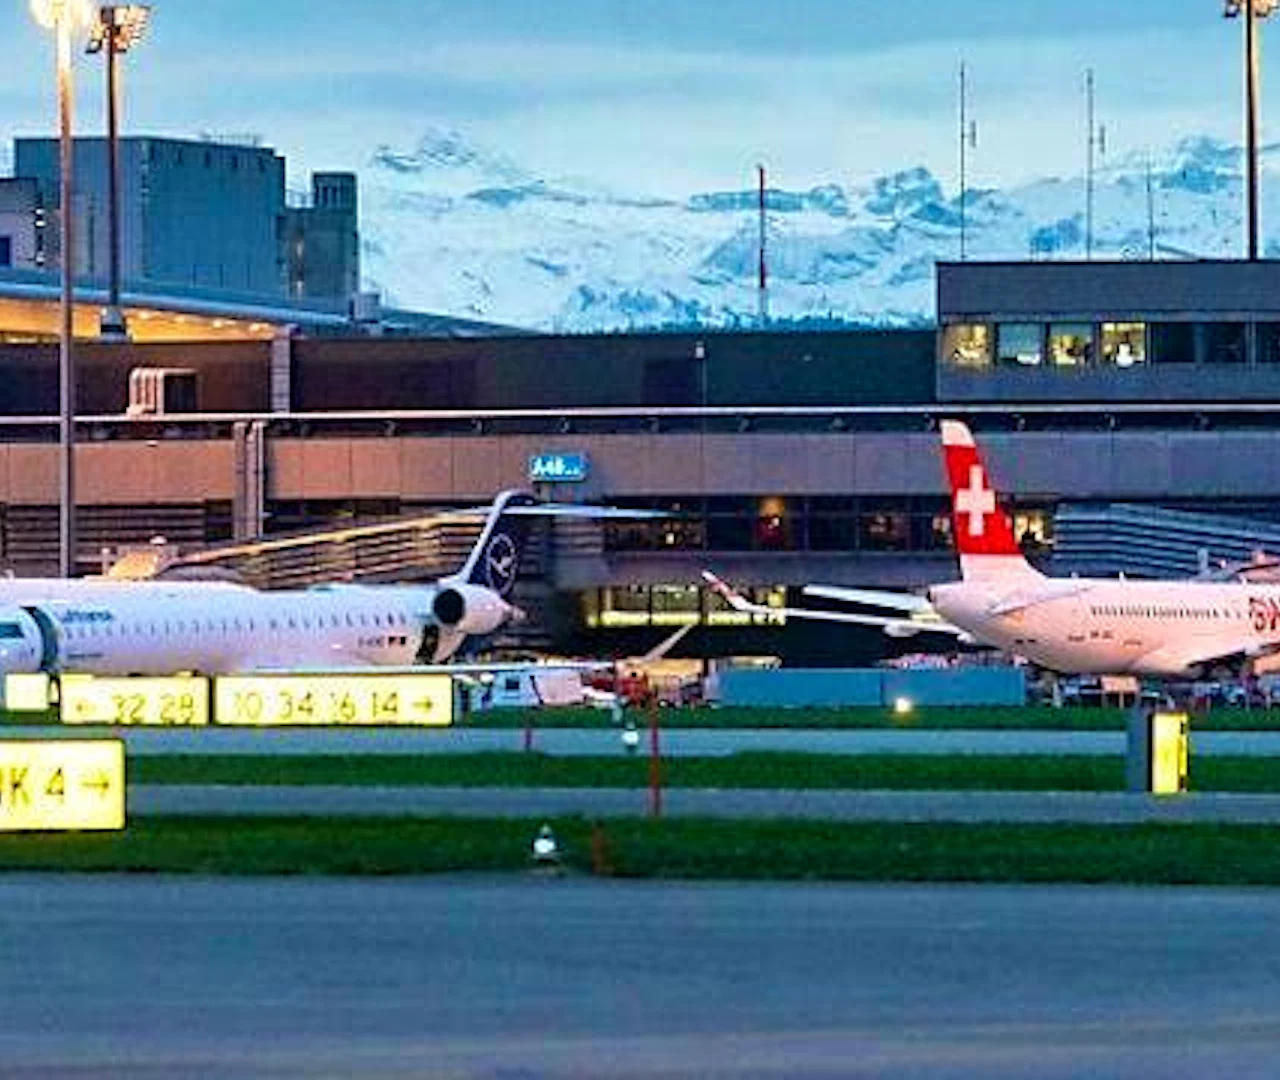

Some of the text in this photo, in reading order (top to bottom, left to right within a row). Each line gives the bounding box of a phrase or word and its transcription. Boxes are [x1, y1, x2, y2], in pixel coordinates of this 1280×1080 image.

[235, 691, 263, 719] 10
[279, 691, 314, 719] 34
[372, 691, 398, 718] 14
[45, 767, 65, 804] 4
